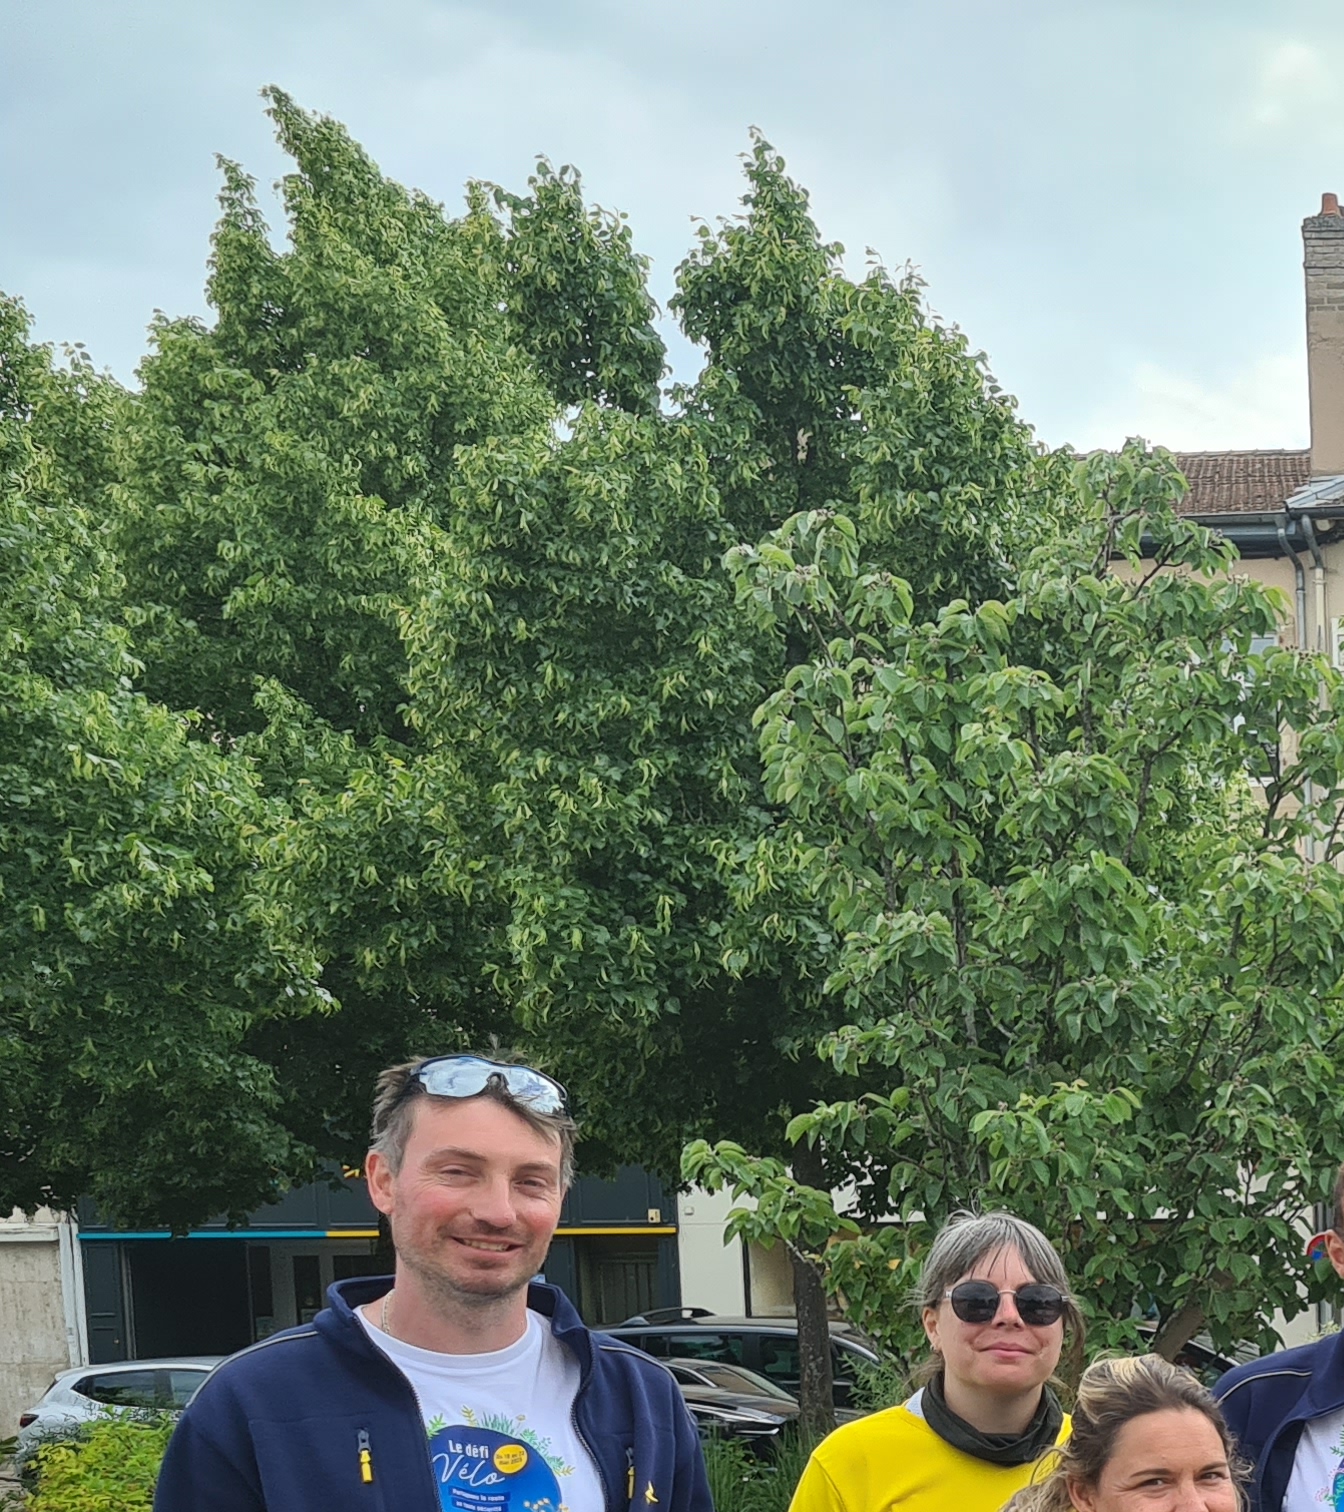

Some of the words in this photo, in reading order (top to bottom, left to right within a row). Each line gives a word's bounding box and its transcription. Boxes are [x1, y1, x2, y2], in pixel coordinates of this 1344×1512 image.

[449, 1440, 462, 1453] Le
[466, 1444, 489, 1459] défi
[432, 1453, 505, 1486] Vélo
